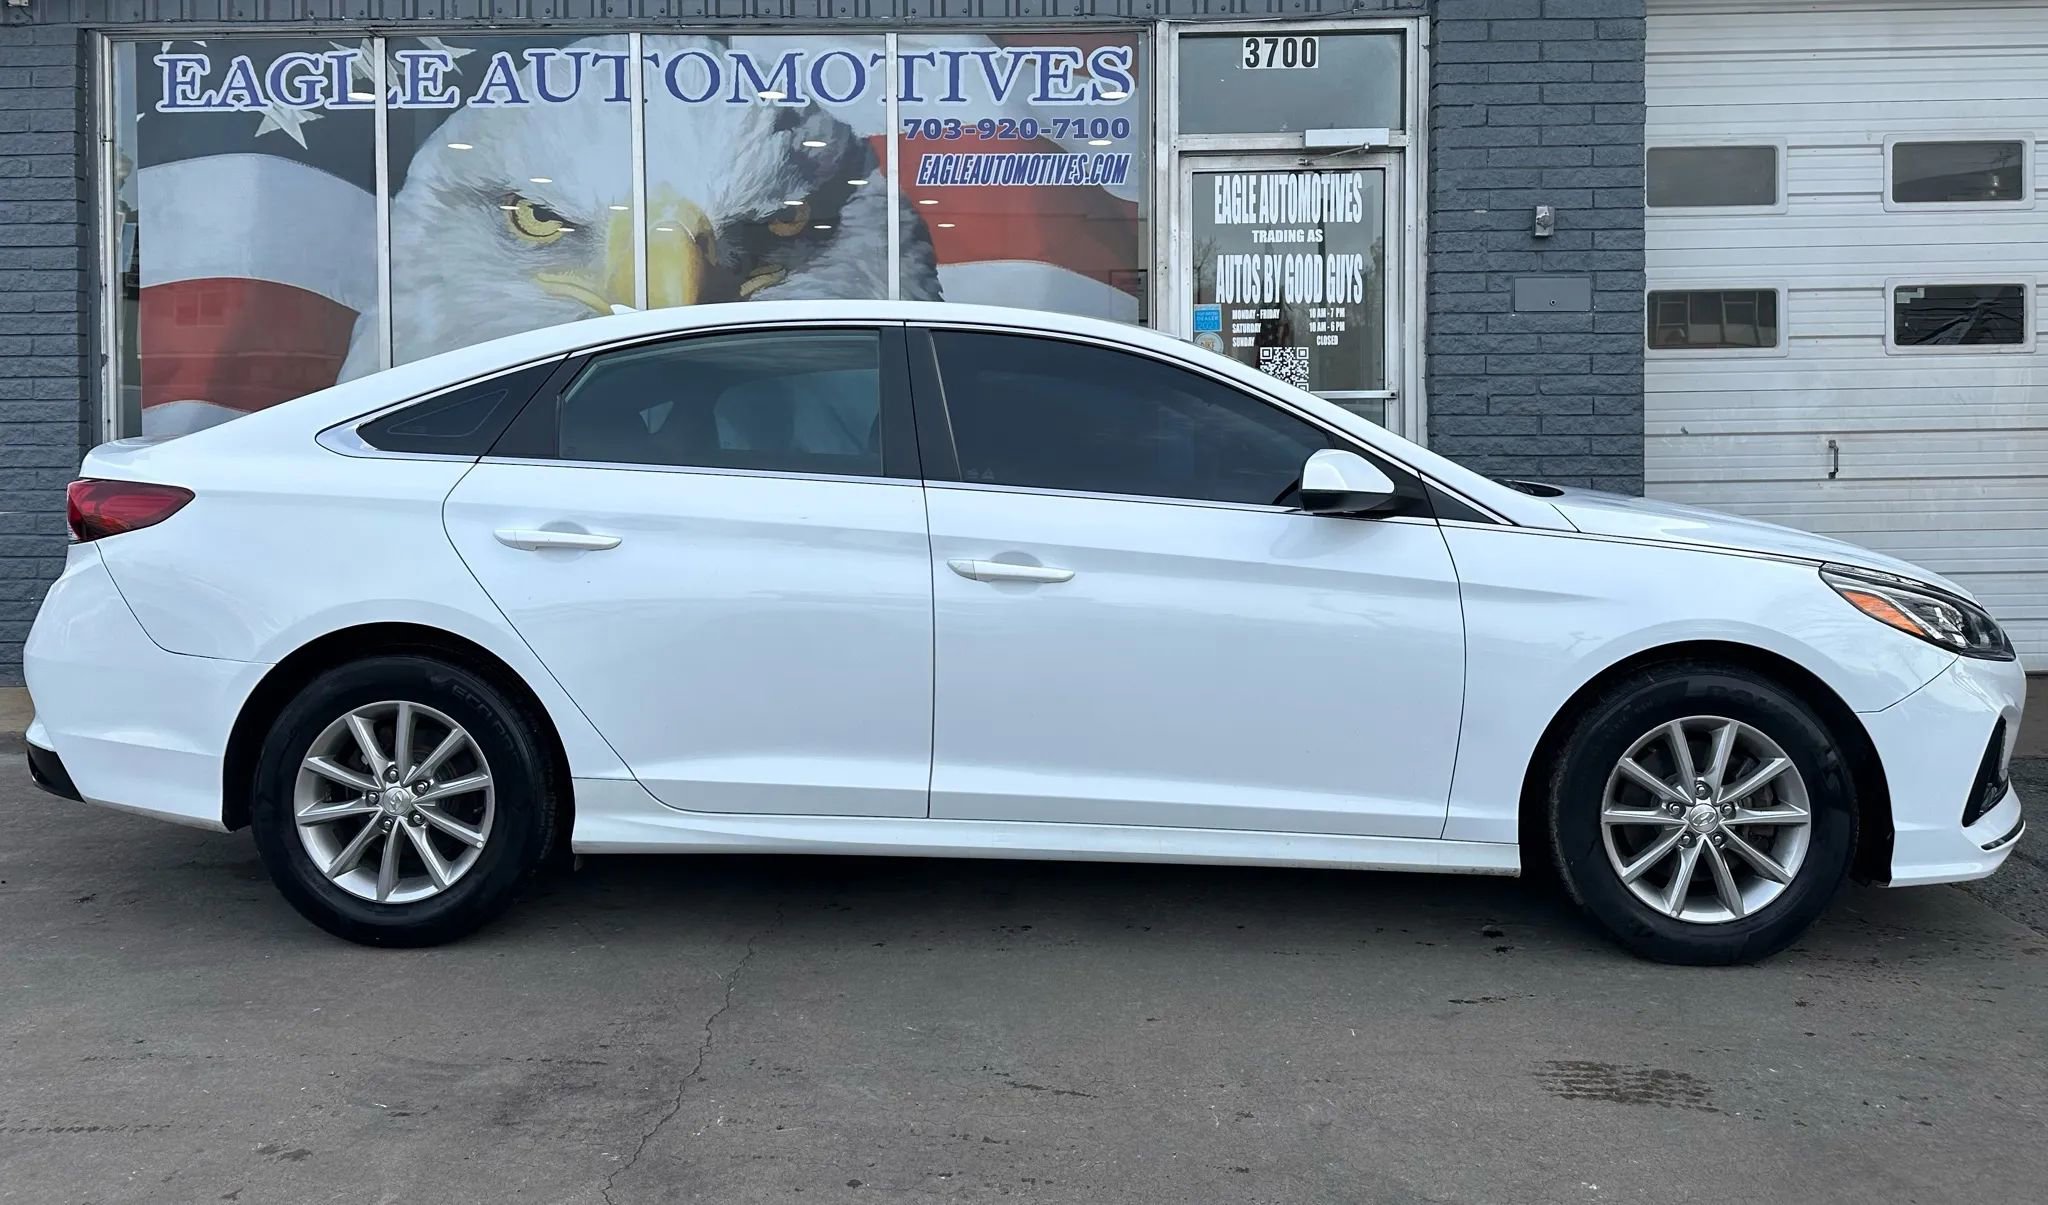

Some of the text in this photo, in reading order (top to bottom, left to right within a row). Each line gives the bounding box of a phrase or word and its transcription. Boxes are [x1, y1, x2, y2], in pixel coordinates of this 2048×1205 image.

[1245, 37, 1317, 68] 3700
[155, 46, 1136, 111] EAGLE AUTOMOTIVES
[903, 118, 1130, 140] 703-920-7100
[917, 153, 1131, 186] EAGLEAUTOMOTIVES.COM
[1214, 172, 1363, 225] EAGLE AUTOMOTIVES
[1251, 229, 1324, 243] TRADING AS
[1215, 253, 1363, 304] AUTOS BY GOOD GUYS
[1231, 309, 1256, 320] MONDAY
[1260, 308, 1280, 320] FRIDAY
[1309, 308, 1317, 319] 10
[1316, 308, 1327, 318] AM
[1330, 308, 1335, 318] 7
[1335, 307, 1346, 318] PM
[1232, 322, 1262, 333] SATURDAY
[1309, 322, 1317, 332] 10
[1316, 321, 1327, 332] AM
[1330, 321, 1335, 331] 6
[1335, 321, 1346, 331] PM
[1232, 337, 1256, 347] SUNDAY
[1316, 335, 1339, 346] CLOSED
